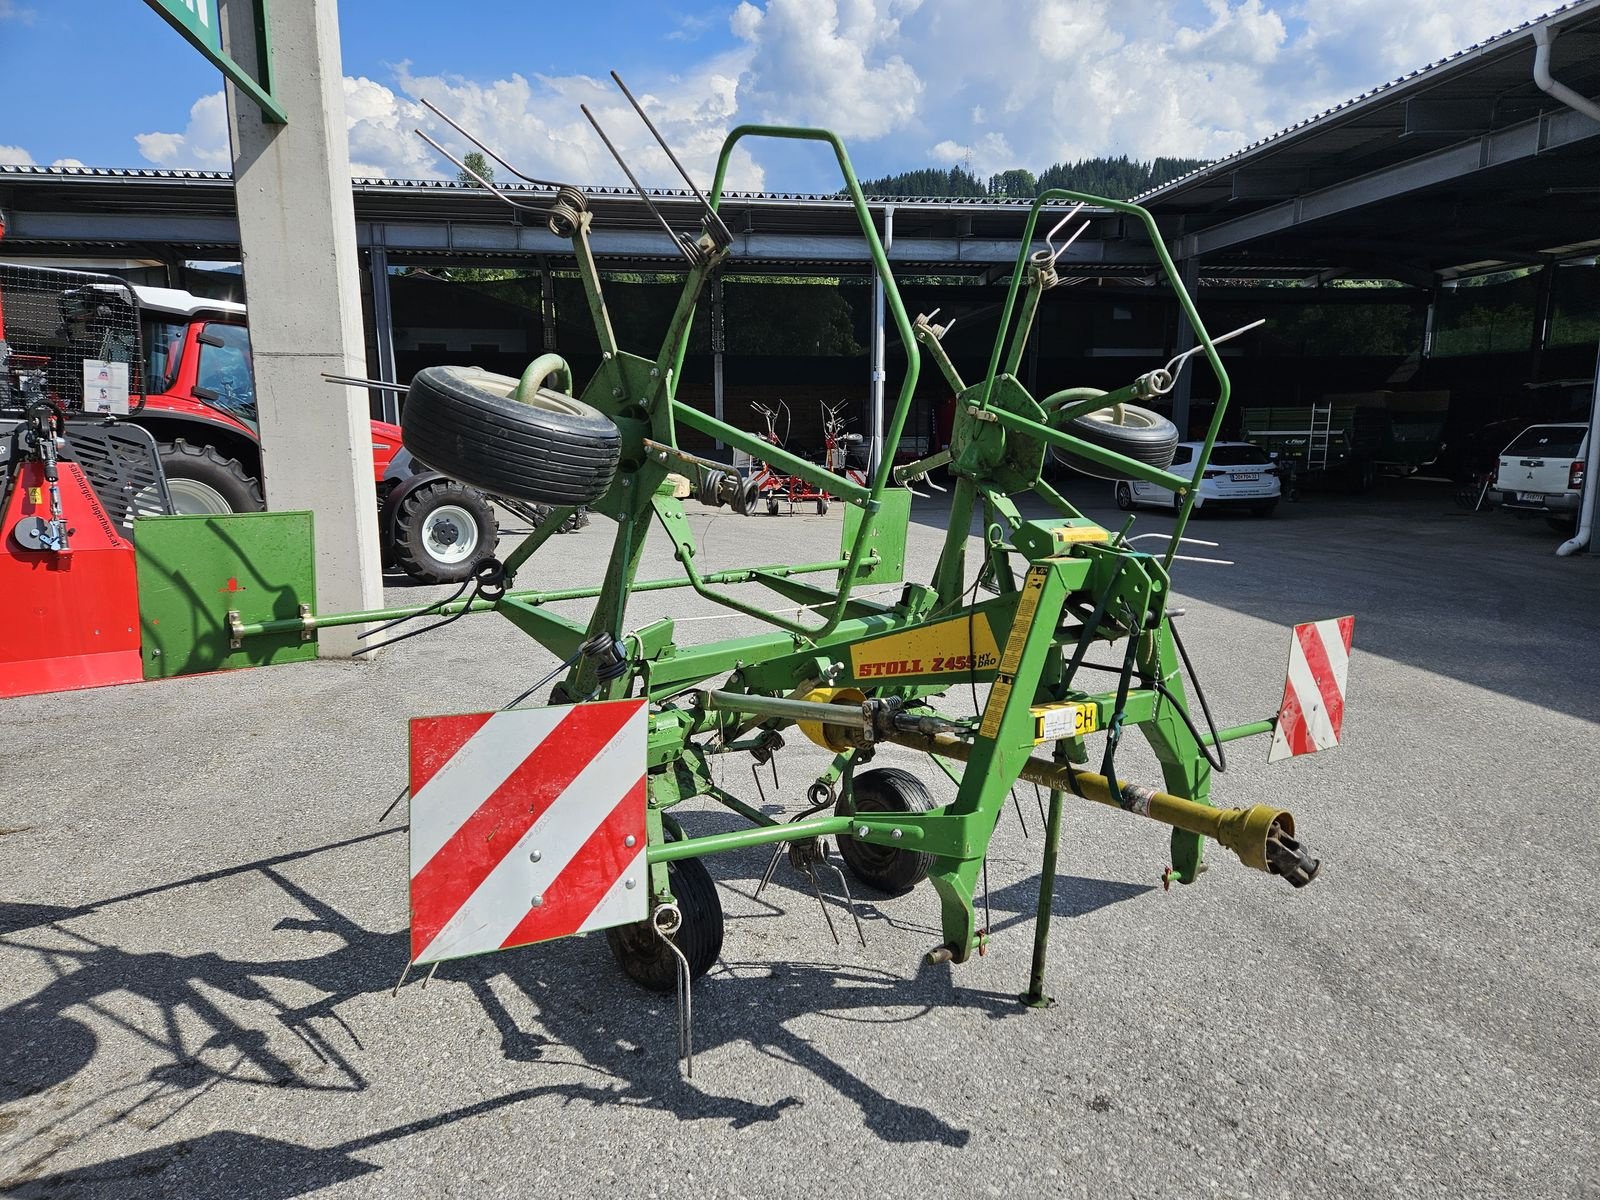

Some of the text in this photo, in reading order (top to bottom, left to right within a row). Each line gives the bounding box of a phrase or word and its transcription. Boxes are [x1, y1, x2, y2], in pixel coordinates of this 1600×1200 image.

[69, 464, 120, 547] salzburger-lagerhaus.at
[859, 652, 992, 677] STOLL Z455 HY
[977, 657, 996, 668] DRO
